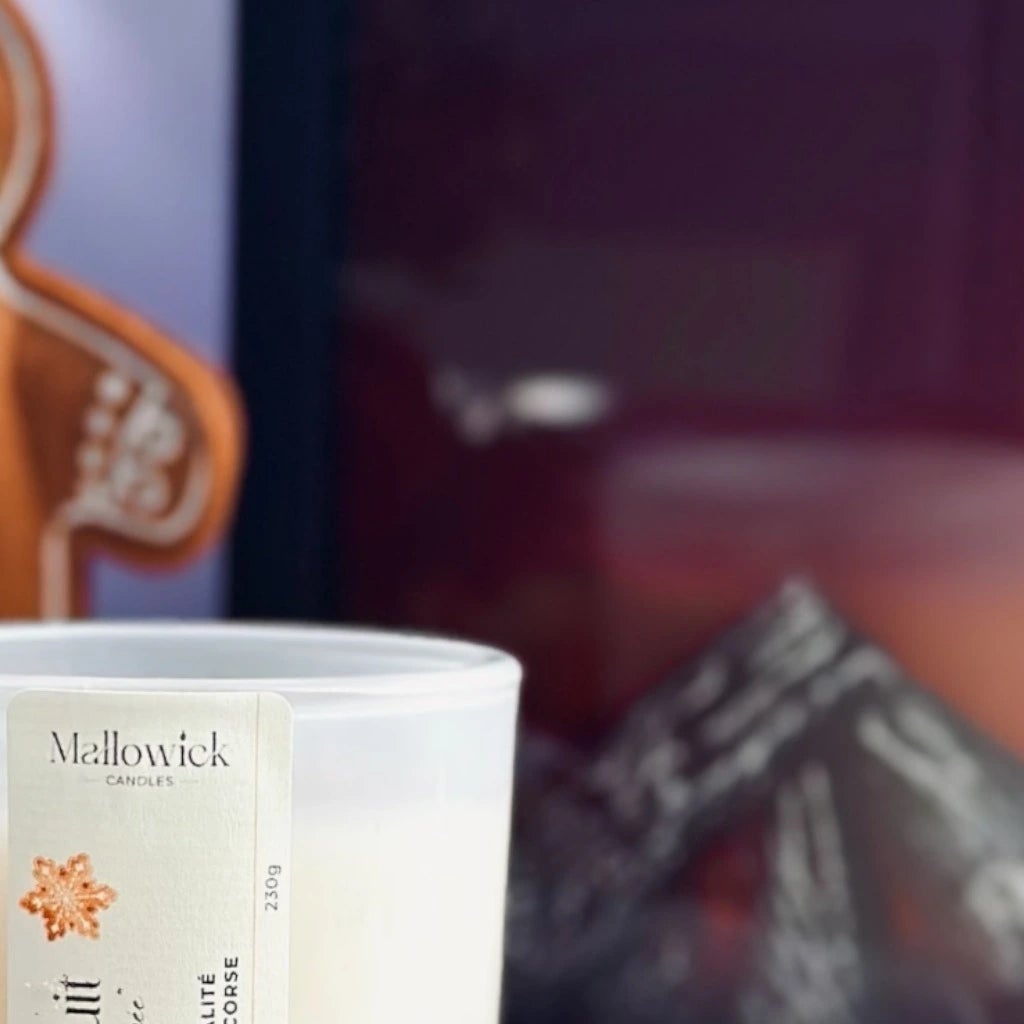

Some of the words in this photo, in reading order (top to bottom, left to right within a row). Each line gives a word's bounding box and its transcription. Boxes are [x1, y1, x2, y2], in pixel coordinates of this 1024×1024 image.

[49, 730, 232, 768] Mallowick
[106, 775, 176, 788] CANDLES
[264, 864, 282, 912] 230g
